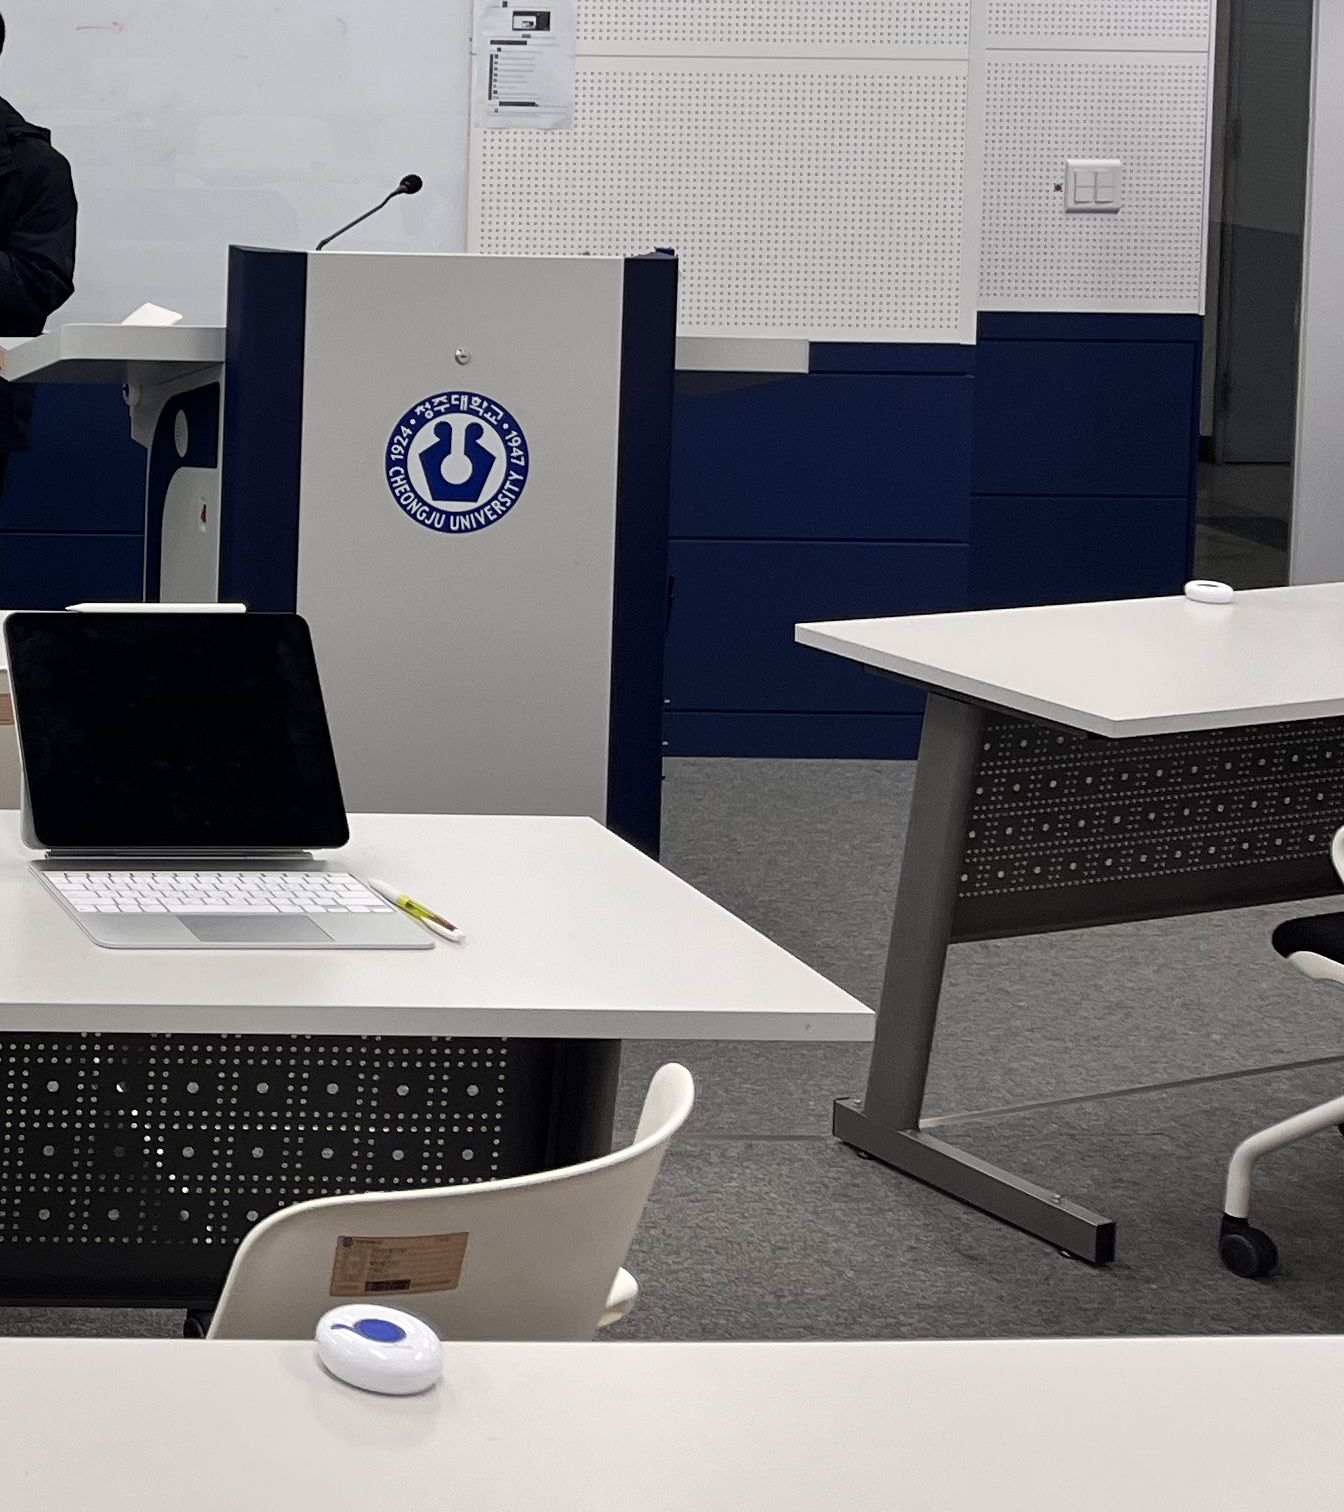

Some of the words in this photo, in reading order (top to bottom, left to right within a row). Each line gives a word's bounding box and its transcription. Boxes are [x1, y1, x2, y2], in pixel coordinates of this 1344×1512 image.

[415, 394, 504, 425] 청주대학교
[390, 425, 413, 461] 1924
[505, 430, 526, 467] 1947
[389, 466, 446, 529] CHEONGJU
[449, 470, 525, 531] UNIVERSITY
